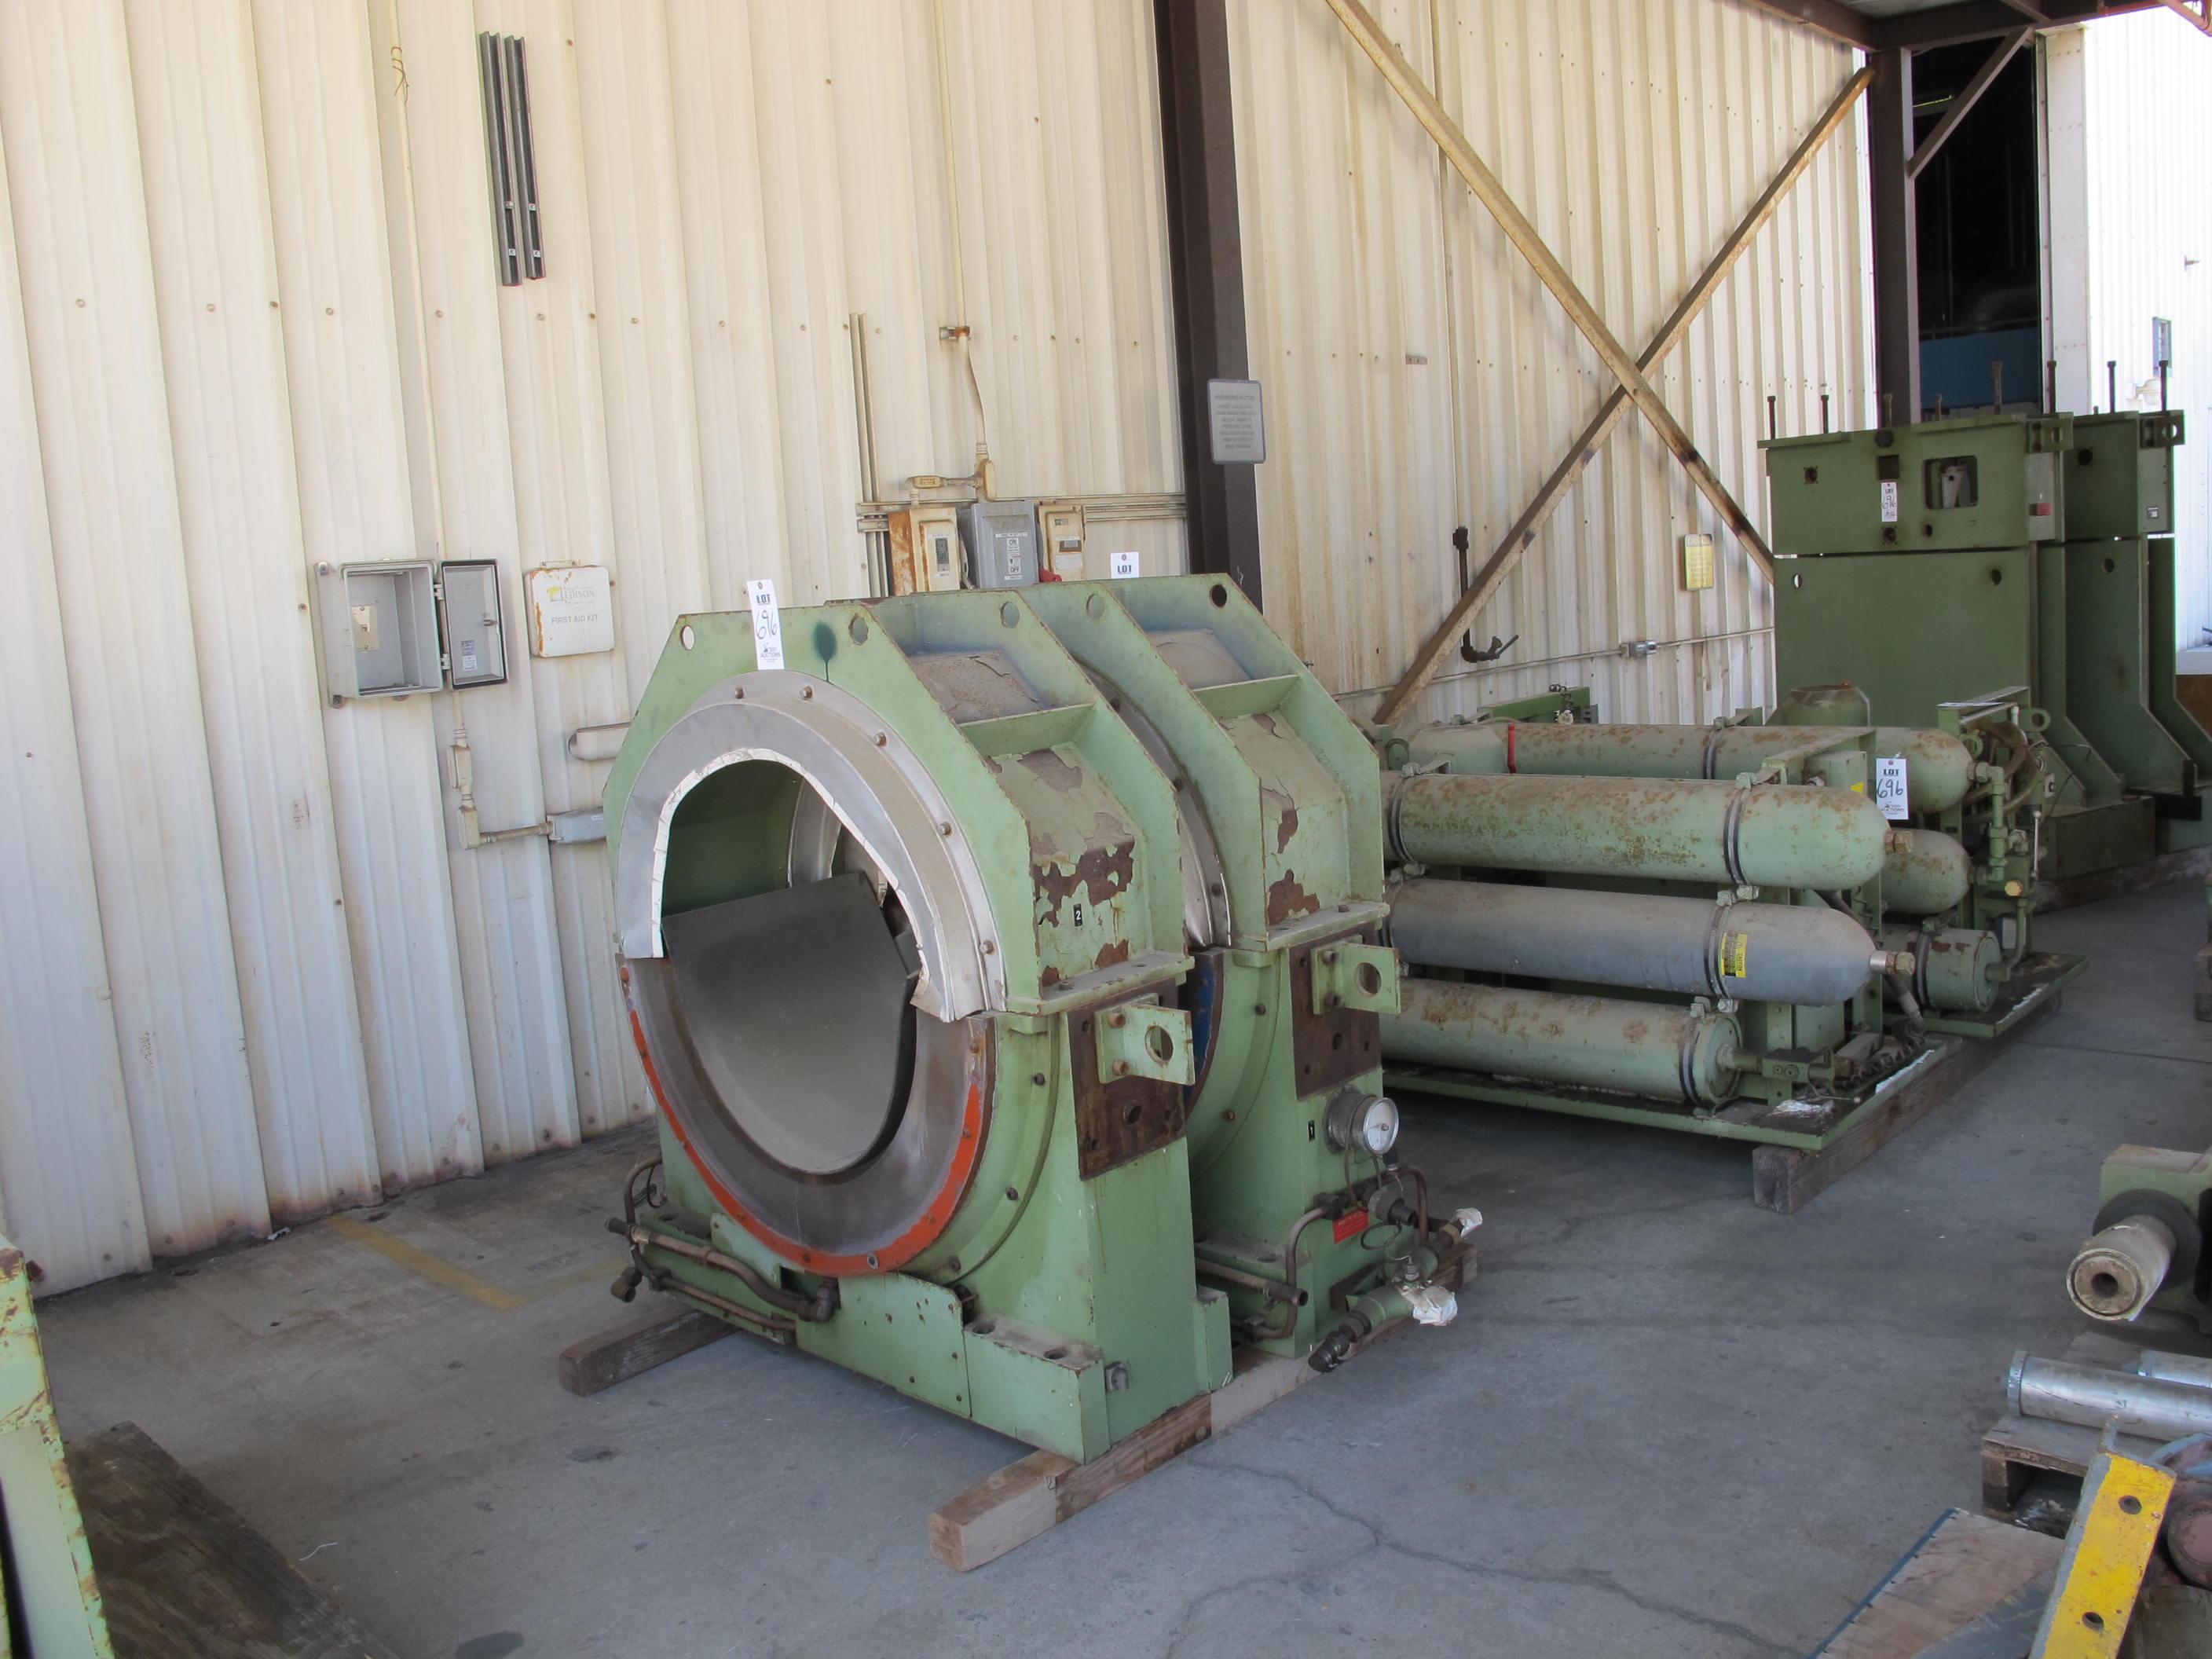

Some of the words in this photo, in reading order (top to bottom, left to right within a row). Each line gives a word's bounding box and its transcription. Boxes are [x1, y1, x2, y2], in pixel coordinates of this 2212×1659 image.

[565, 590, 595, 599] EDISON
[756, 594, 771, 604] LOT
[551, 616, 573, 624] FIRST
[1877, 778, 1904, 799] 696
[1076, 910, 1082, 920] 2
